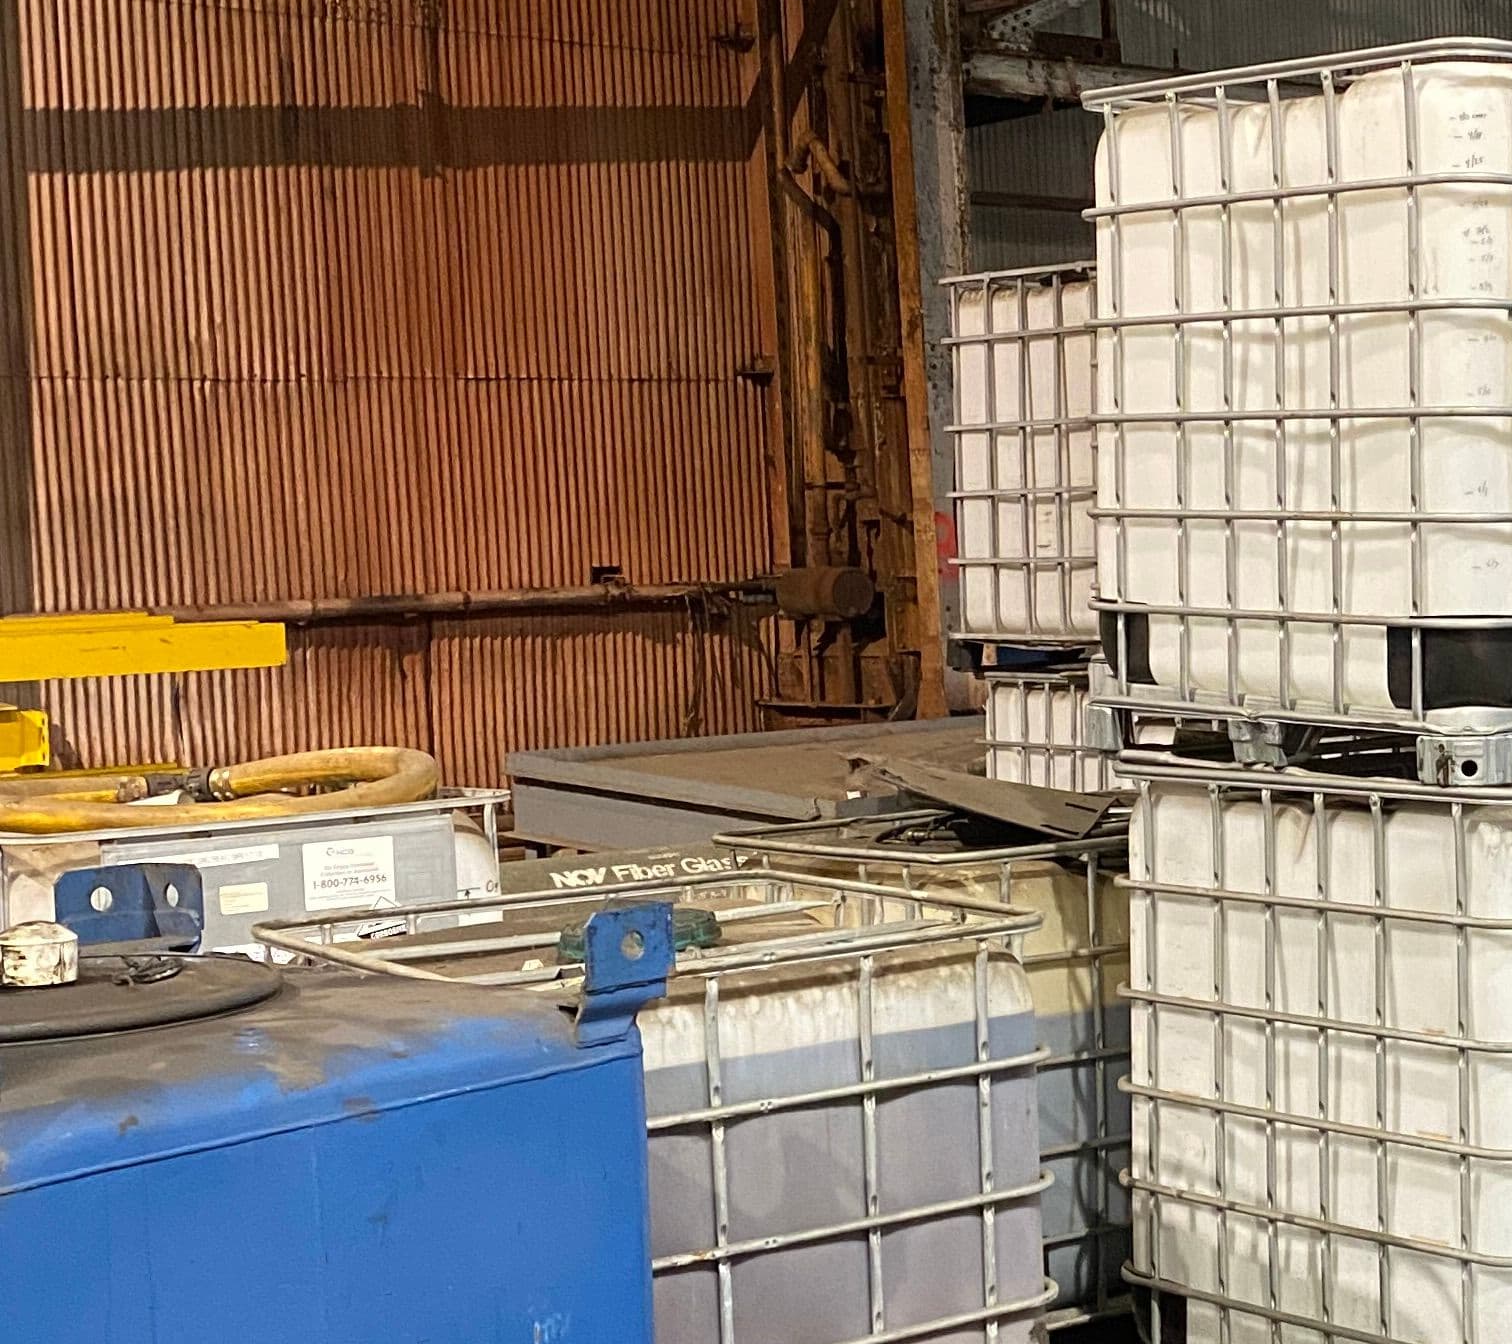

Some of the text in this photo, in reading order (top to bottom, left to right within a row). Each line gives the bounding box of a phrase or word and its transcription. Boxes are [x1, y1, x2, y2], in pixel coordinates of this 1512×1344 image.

[313, 874, 387, 889] 1-800-774-6956
[549, 866, 607, 889] NOV
[610, 862, 675, 881] Fiber
